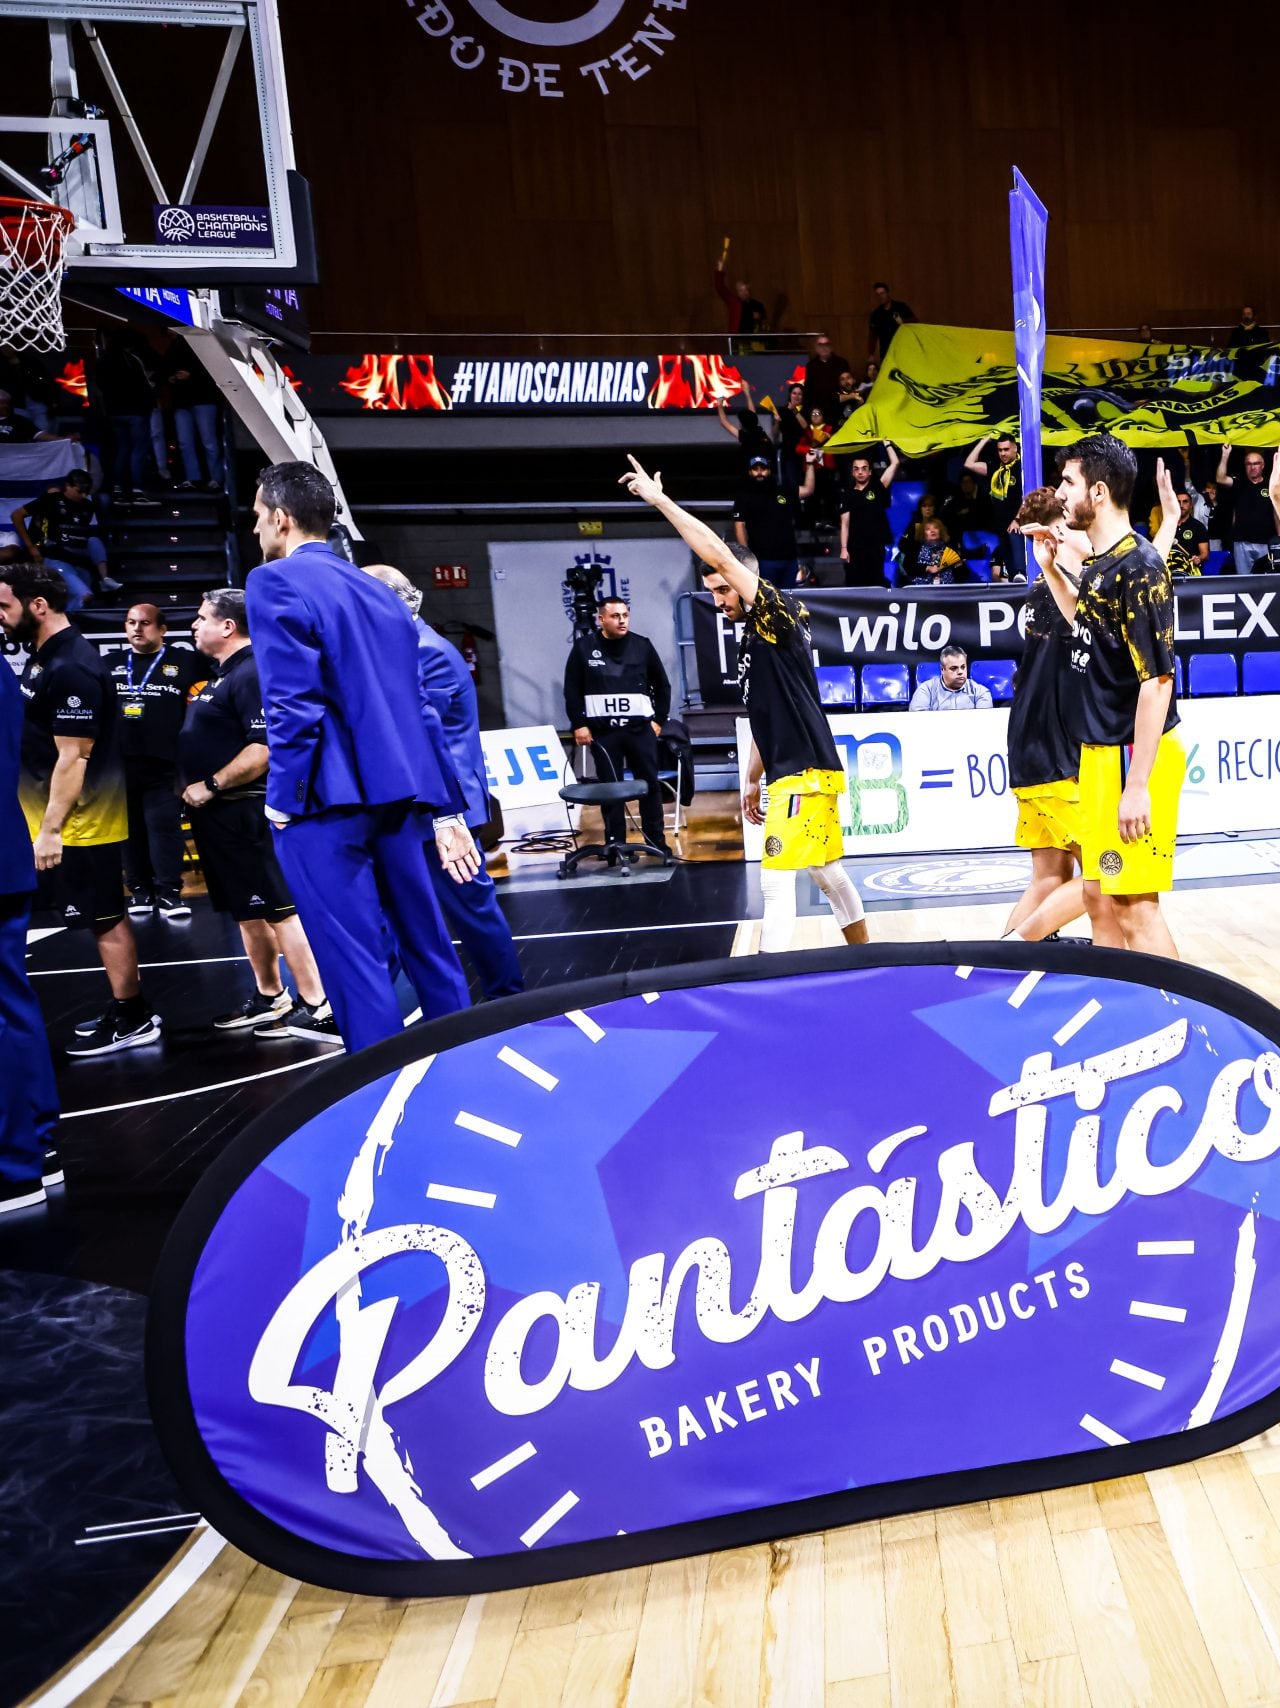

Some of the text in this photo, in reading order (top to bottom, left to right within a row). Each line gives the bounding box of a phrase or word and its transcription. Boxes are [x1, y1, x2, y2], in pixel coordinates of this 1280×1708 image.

[404, 0, 485, 69] DO
[498, 57, 564, 97] DE
[196, 213, 259, 223] BASKETBALL
[197, 222, 268, 232] CHAMPIONS
[198, 231, 237, 239] LEAGUE
[451, 362, 649, 402] #VAMOSCANARIAS
[839, 602, 951, 653] wilo
[146, 683, 181, 696] Service
[604, 698, 631, 713] HB
[638, 1261, 1092, 1459] BAKERY PRODUCTS
